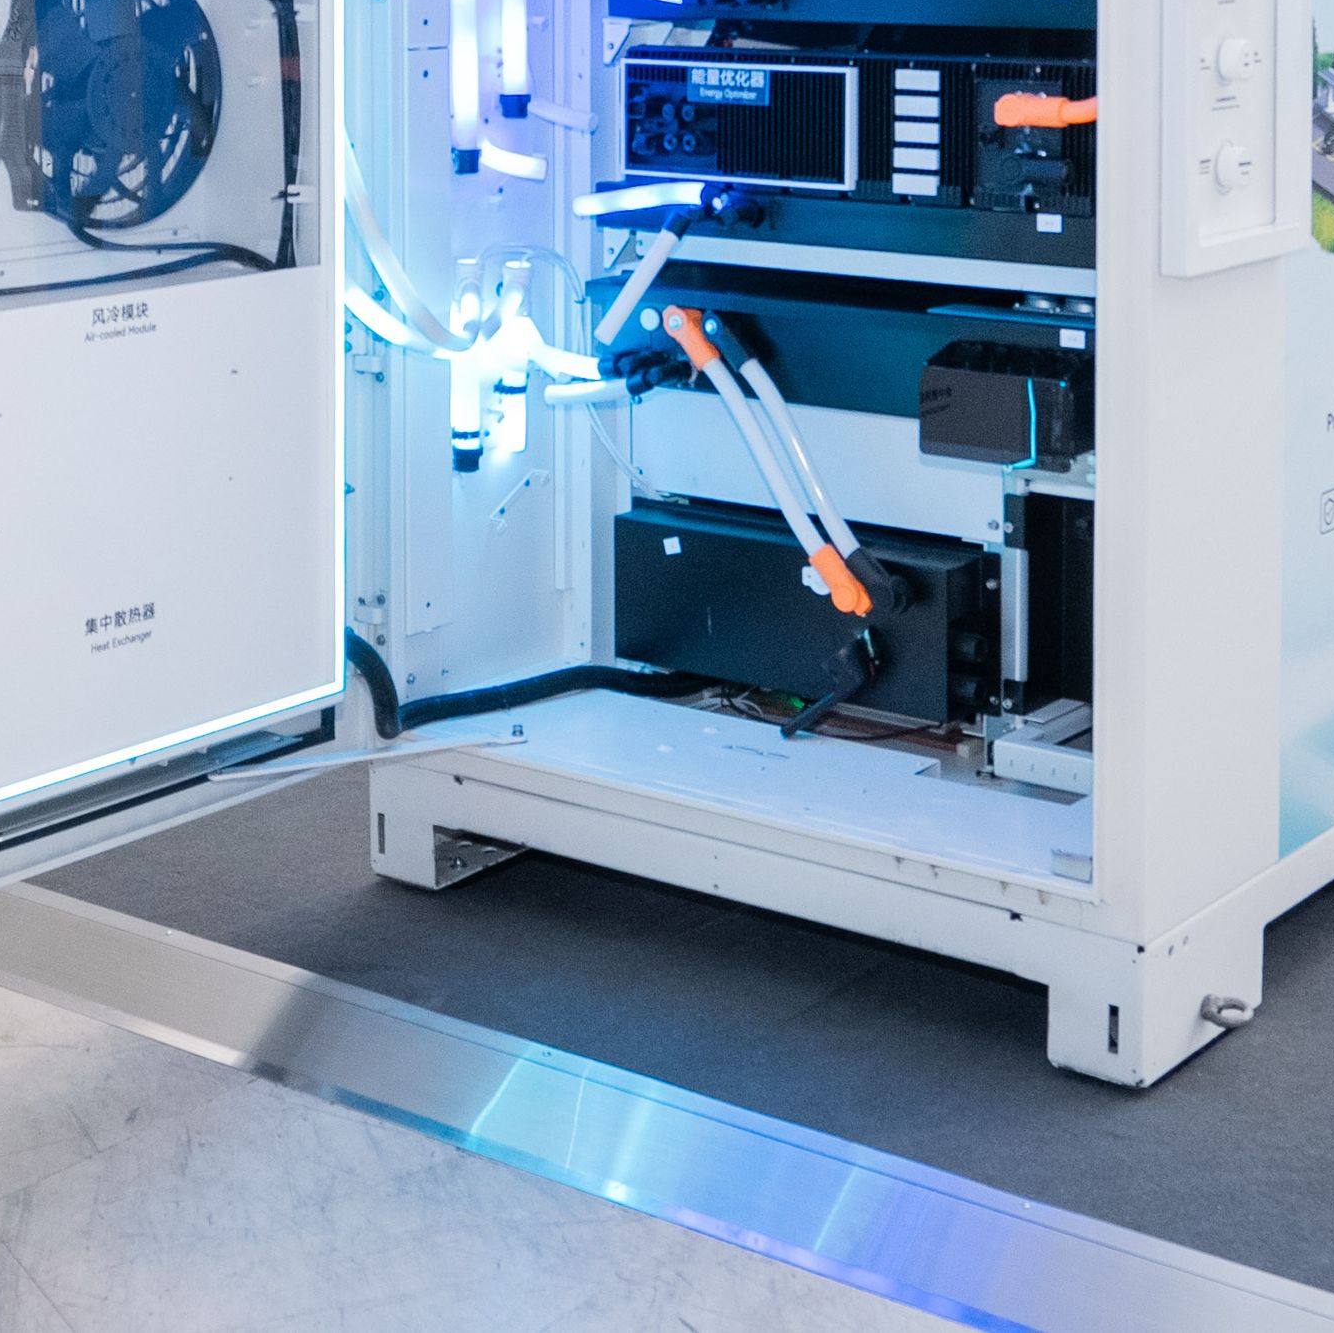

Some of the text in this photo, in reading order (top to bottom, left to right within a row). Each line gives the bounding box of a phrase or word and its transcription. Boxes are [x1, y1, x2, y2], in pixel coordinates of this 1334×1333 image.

[691, 68, 764, 88] 能量优化器
[699, 87, 757, 100] Energy Optimizer
[92, 301, 149, 326] 风冷模块
[84, 322, 156, 342] Air-cooled Module
[85, 602, 155, 636] 集中散热器
[91, 640, 110, 654] Heat
